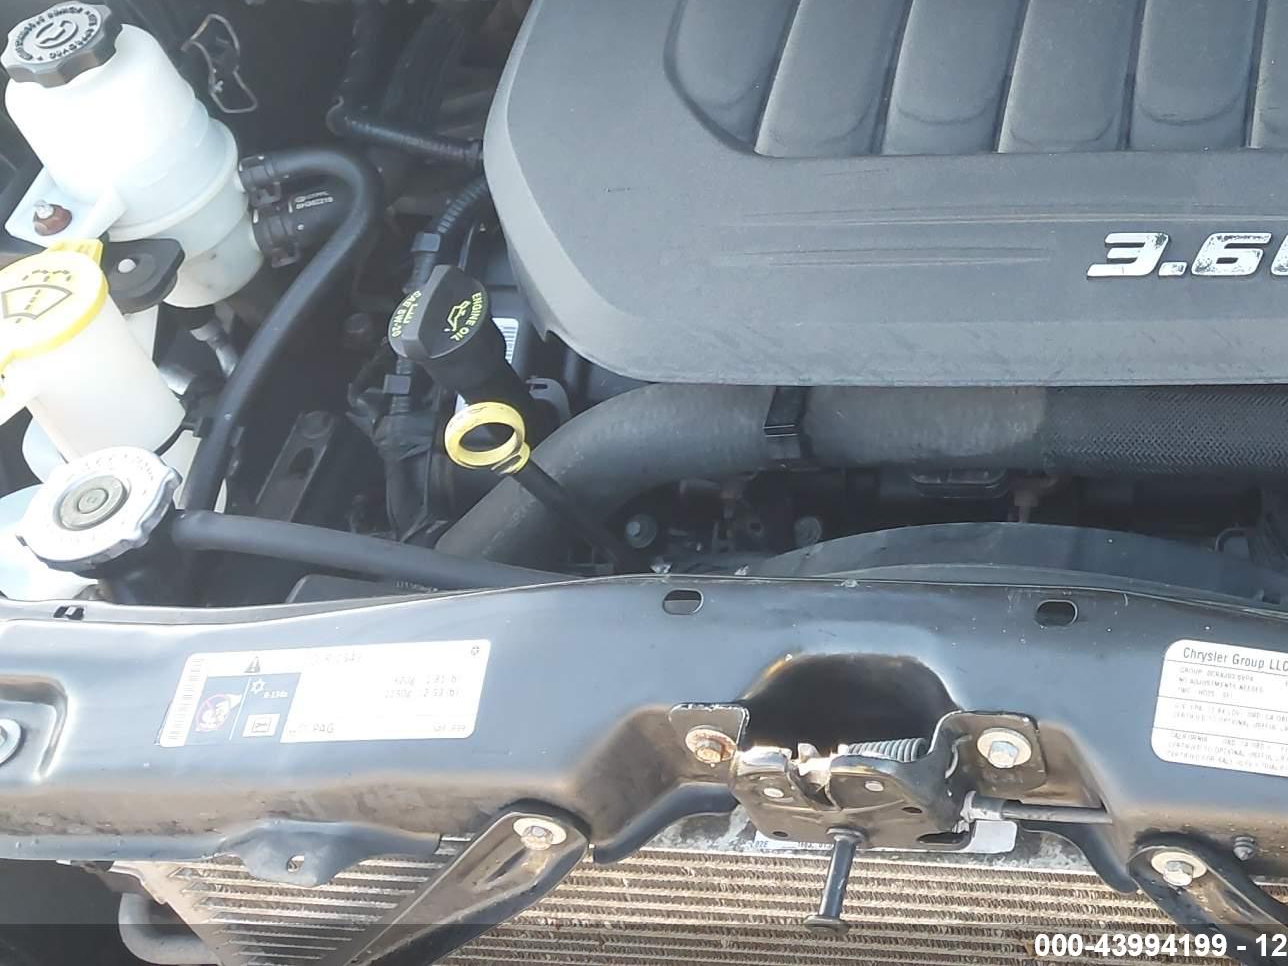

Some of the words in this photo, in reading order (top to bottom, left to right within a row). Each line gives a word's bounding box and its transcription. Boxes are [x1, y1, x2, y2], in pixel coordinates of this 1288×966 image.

[466, 292, 482, 326] ENGINE
[450, 327, 470, 341] OIL
[1182, 646, 1229, 666] Chrysler
[1231, 653, 1266, 670] Group
